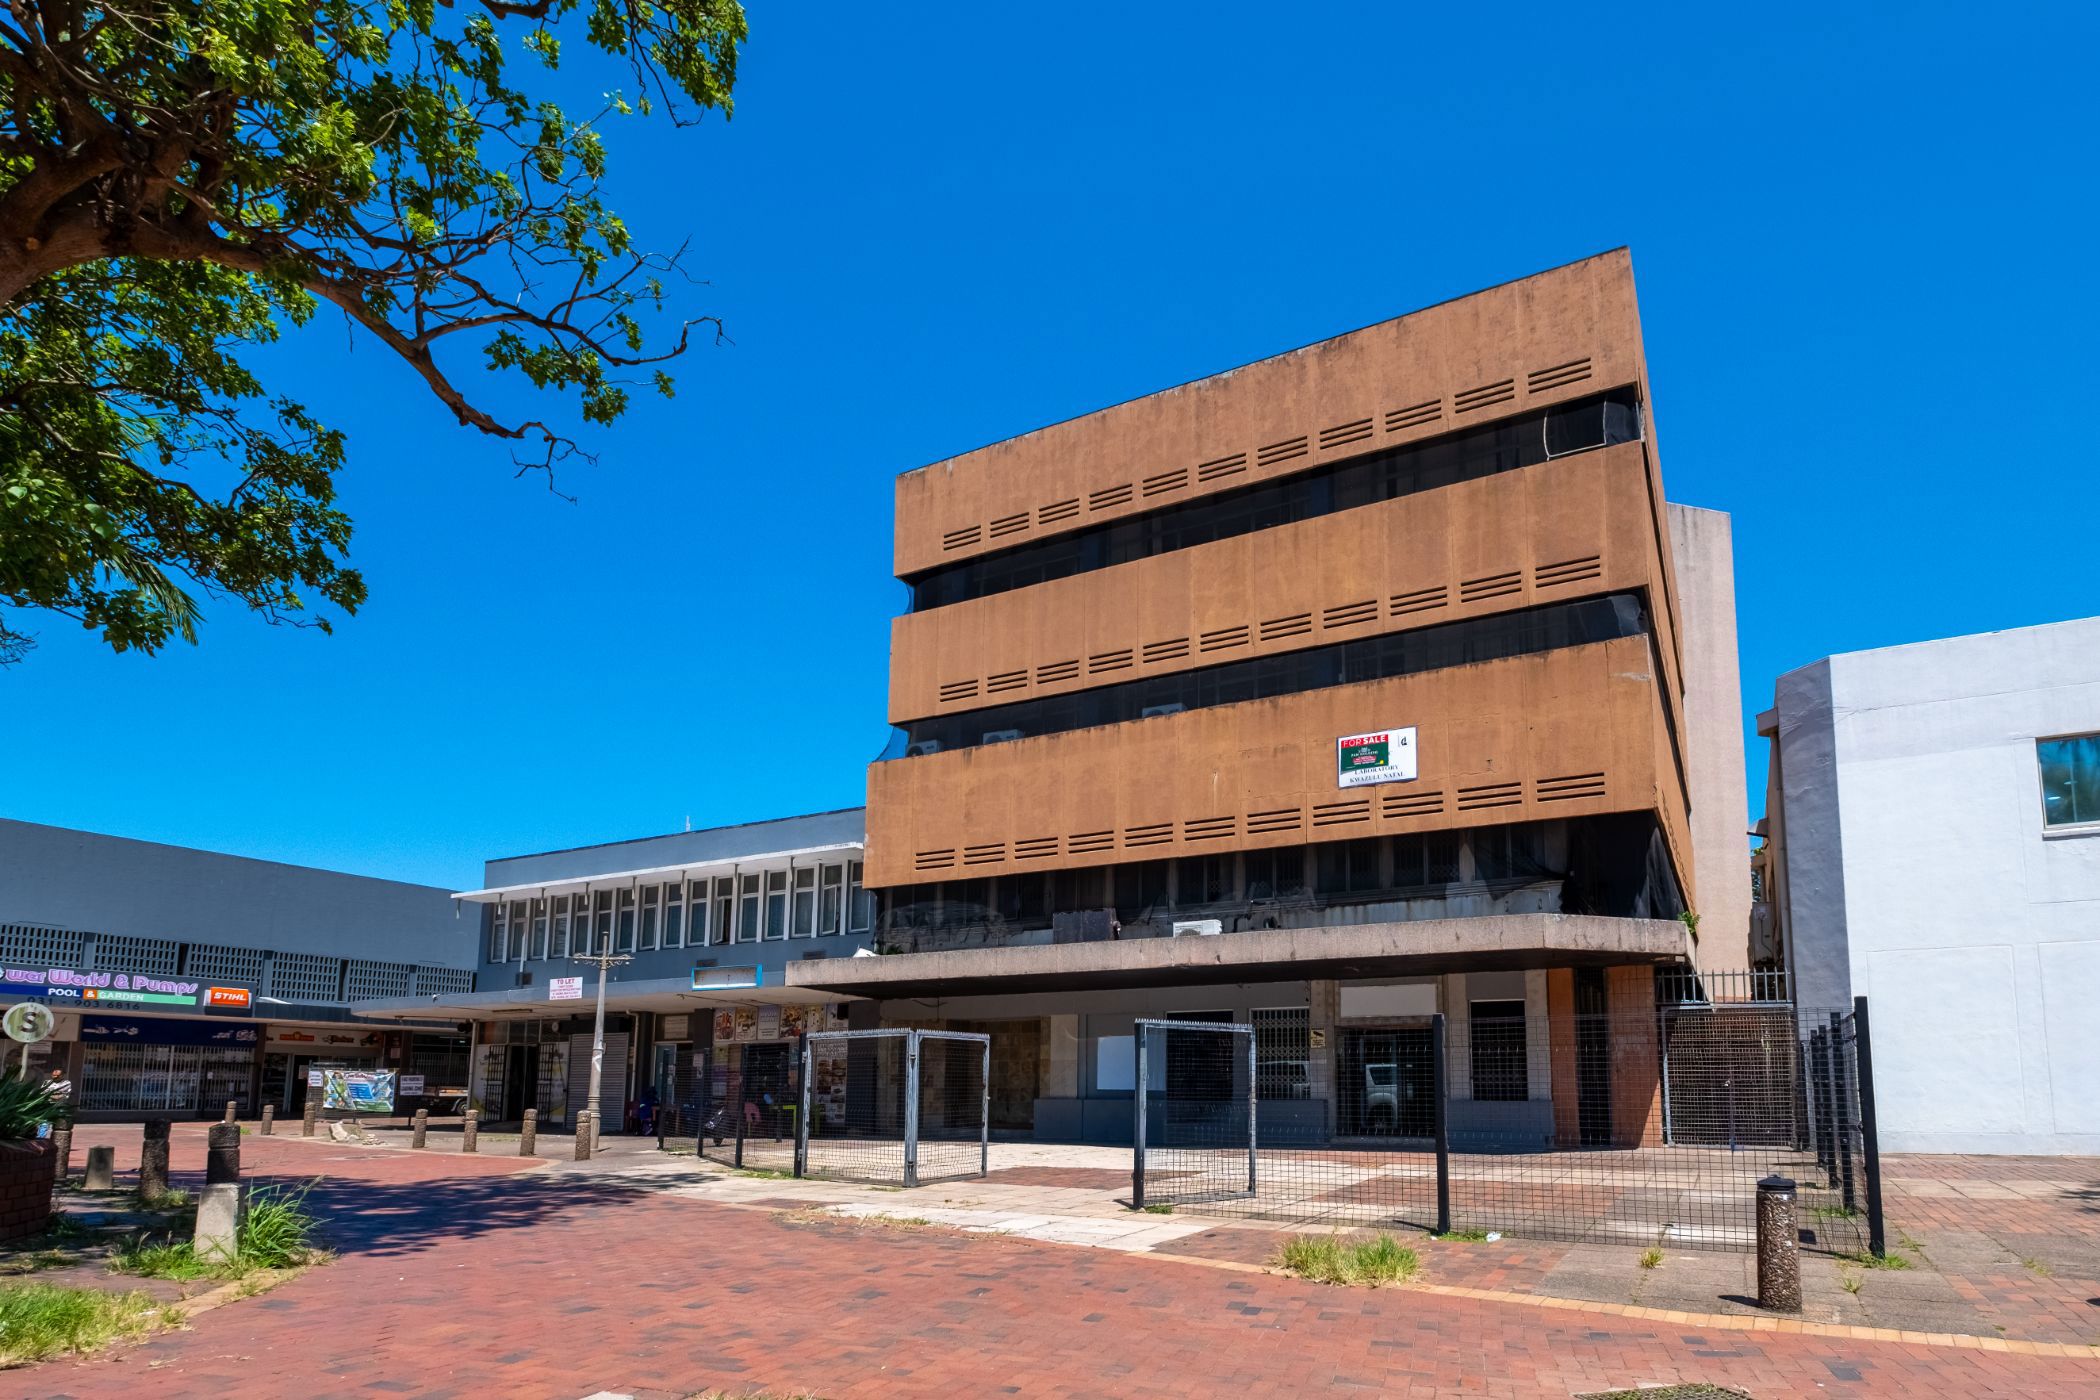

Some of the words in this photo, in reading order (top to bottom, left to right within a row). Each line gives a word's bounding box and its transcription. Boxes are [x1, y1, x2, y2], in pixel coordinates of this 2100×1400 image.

[1344, 739, 1361, 747] FOR
[1364, 736, 1386, 745] SALE
[0, 967, 46, 983] wer
[48, 969, 111, 988] World
[114, 974, 130, 989] &
[132, 975, 199, 996] Pumps
[47, 988, 81, 997] POOL
[86, 990, 95, 998] &
[98, 991, 144, 1001] GARDEN
[213, 992, 247, 1001] STIHL
[75, 999, 100, 1008] 903
[107, 1001, 140, 1011] 6816
[21, 1012, 39, 1033] S
